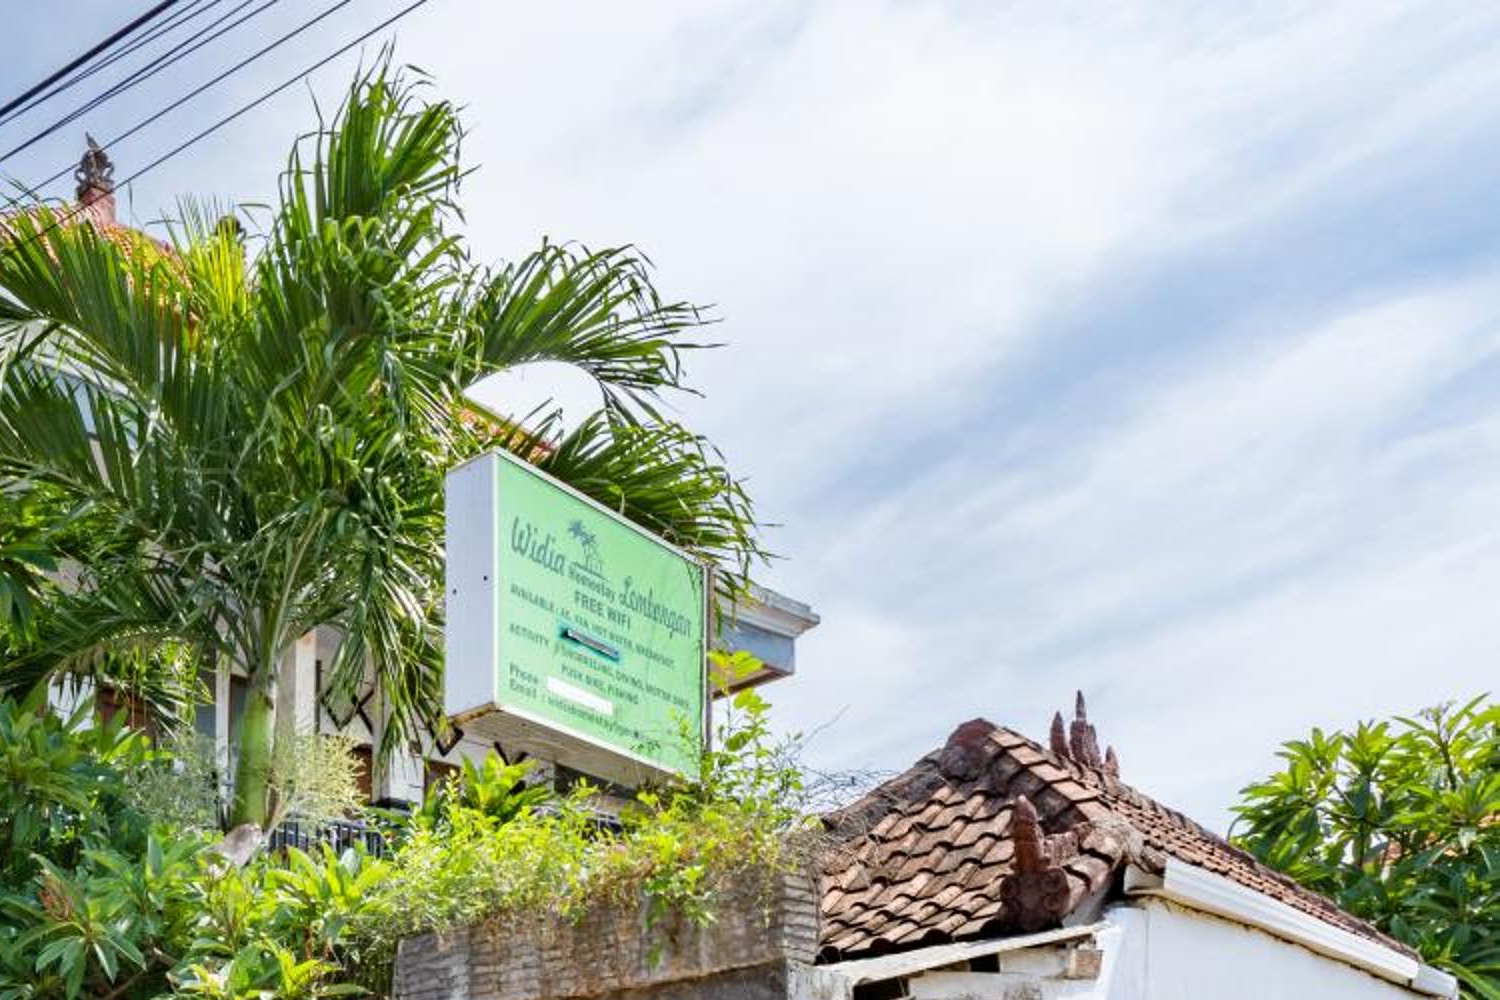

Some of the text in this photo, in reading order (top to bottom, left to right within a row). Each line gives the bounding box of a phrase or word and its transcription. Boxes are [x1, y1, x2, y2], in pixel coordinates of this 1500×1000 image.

[511, 516, 565, 576] Widia
[575, 589, 631, 631] FREE WIFI
